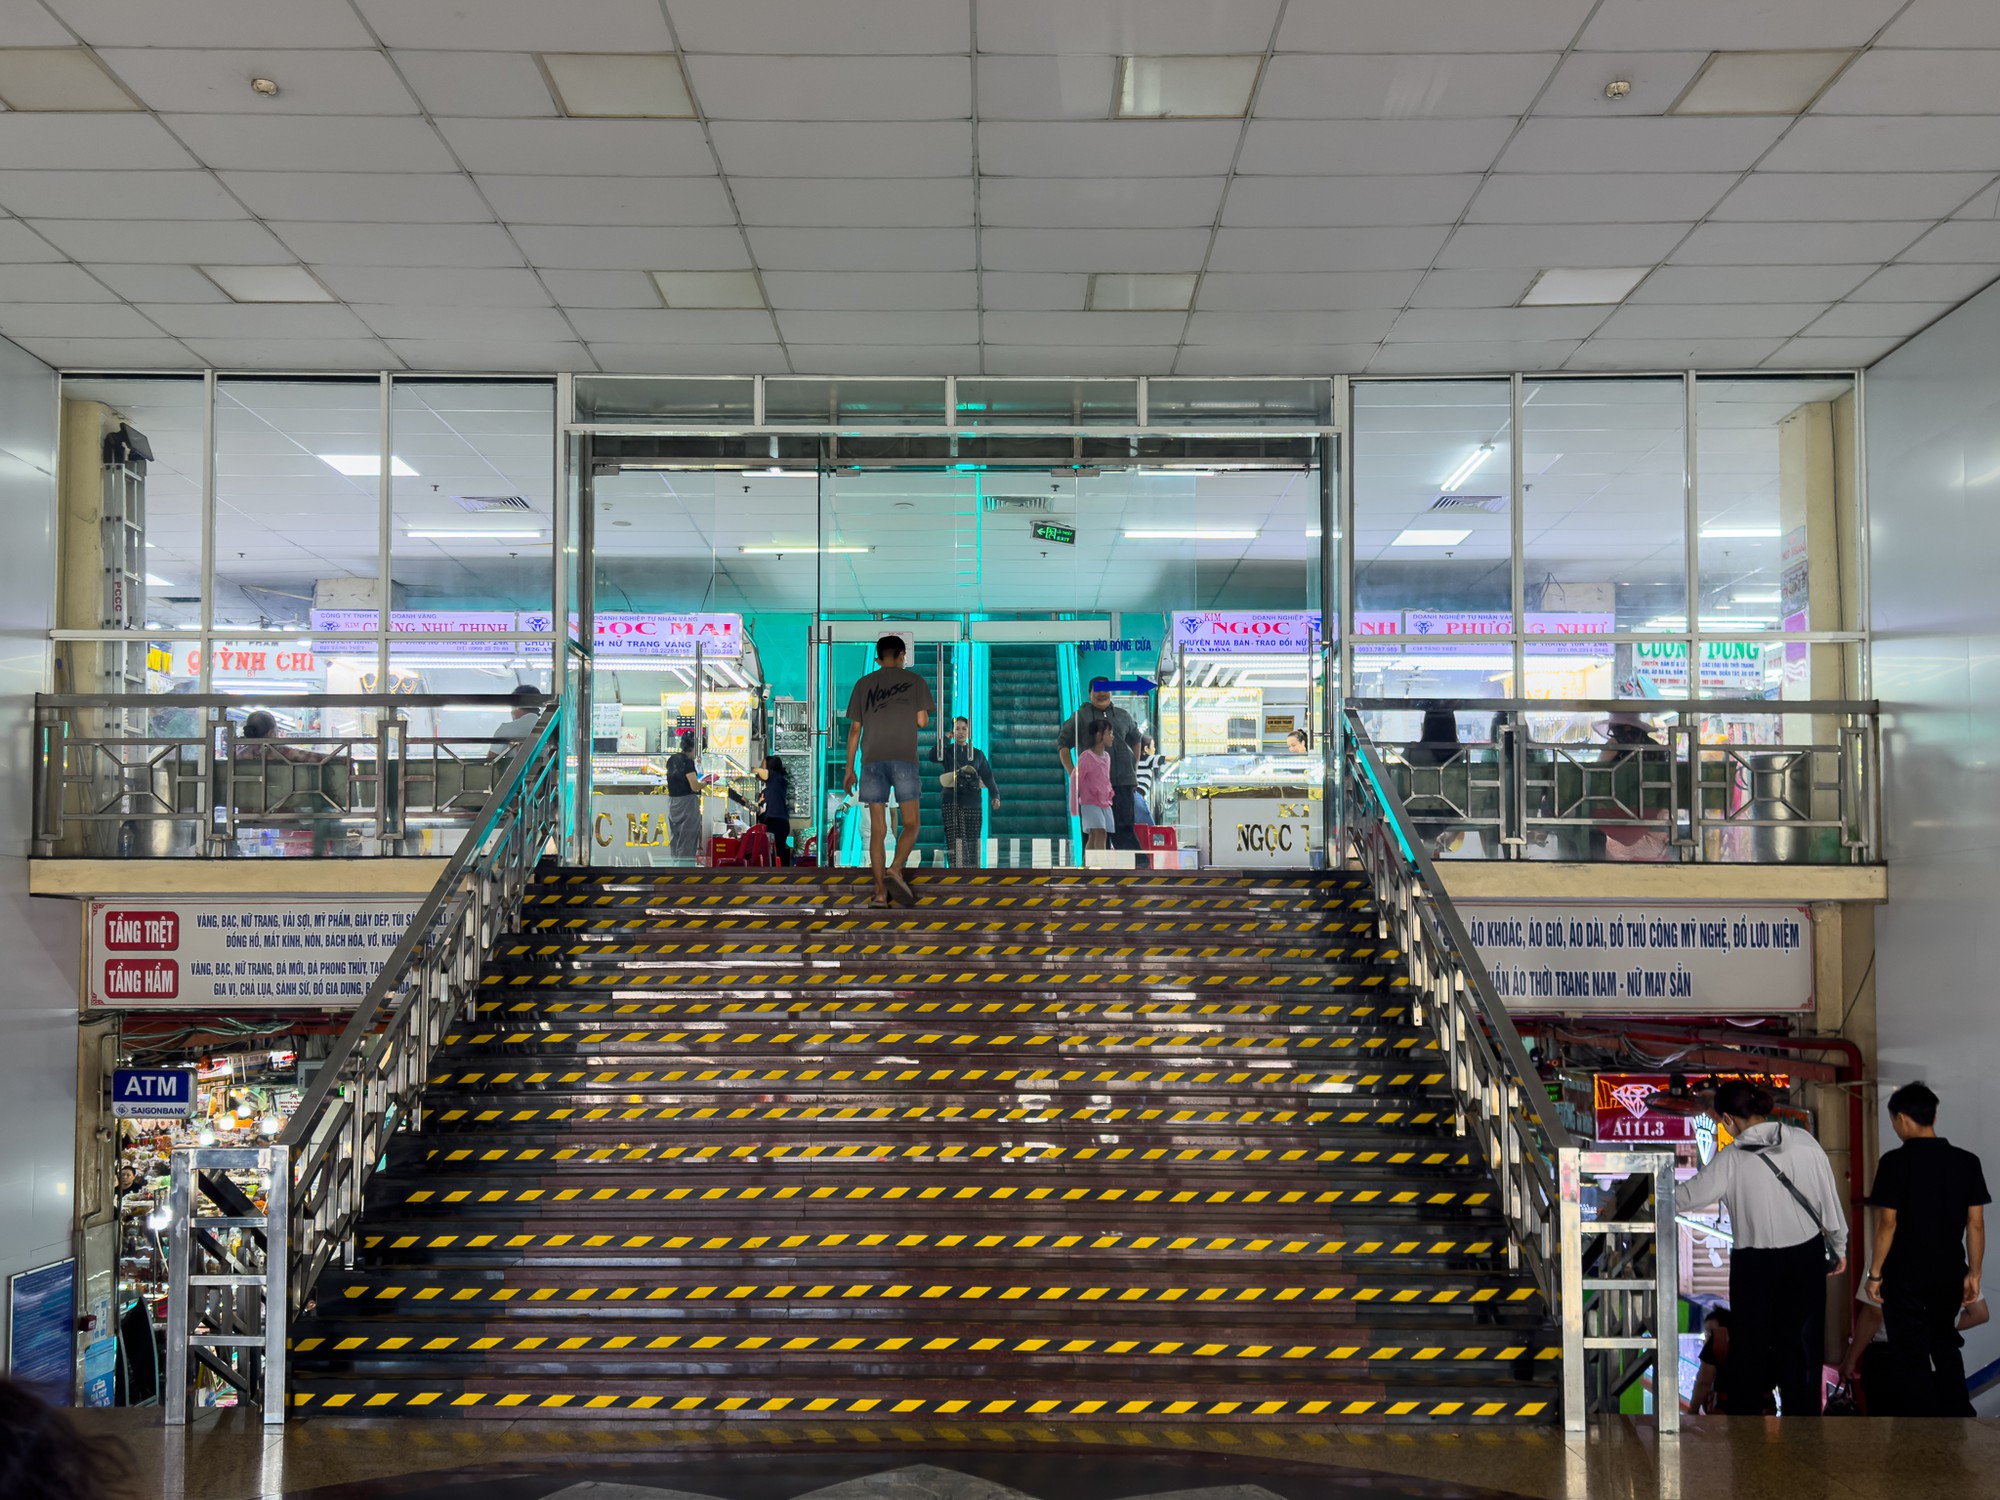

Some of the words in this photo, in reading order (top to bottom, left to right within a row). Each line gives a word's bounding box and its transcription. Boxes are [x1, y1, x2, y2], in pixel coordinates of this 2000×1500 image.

[1440, 613, 1466, 621] NGHIỆP
[1478, 613, 1498, 621] NHÂN
[1446, 620, 1546, 634] PHƯƠG
[670, 622, 731, 636] MAI
[1211, 621, 1292, 638] NGỌC
[608, 640, 623, 648] NỮ
[1080, 640, 1090, 651] RA
[1093, 638, 1107, 651] VÀO
[1109, 638, 1132, 651] ĐÓNG
[187, 647, 267, 675] QỲNH
[276, 651, 316, 671] CHI
[625, 812, 670, 847] MA
[1236, 823, 1293, 857] NGỌC
[197, 912, 219, 929] VÀNG,
[221, 914, 239, 930] BẠC,
[241, 912, 253, 928] NỮ
[254, 914, 281, 929] TRANG,
[314, 912, 326, 928] MỸ
[328, 909, 353, 928] PHẨM,
[355, 911, 372, 927] GIÀY
[374, 911, 390, 928] DÉP,
[392, 911, 403, 927] TÚI
[109, 912, 141, 943] TẦNG
[144, 916, 174, 948] TRỆT
[282, 932, 303, 948] KÍNH,
[304, 932, 323, 948] NÓN,
[325, 932, 346, 947] BÁCH
[348, 932, 365, 948] HÓA,
[1470, 916, 1484, 947] ÁO
[1487, 916, 1526, 949] KHOÁC,
[1528, 917, 1542, 947] ÁO
[1545, 917, 1567, 950] GIÓ,
[1569, 917, 1583, 947] ÁO
[1586, 917, 1607, 950] DÀI,
[1609, 914, 1624, 948] ĐỒ
[1626, 914, 1647, 948] THỦ
[1650, 917, 1678, 948] CÔNG
[1681, 918, 1697, 948] MỸ
[1700, 916, 1731, 953] NGHỆ,
[1733, 914, 1748, 948] ĐỒ
[1750, 920, 1769, 948] LƯU
[1772, 917, 1800, 953] NIỆM
[109, 962, 141, 993] TẦNG
[145, 962, 173, 993] HẦM
[191, 960, 213, 976] VÀNG,
[215, 962, 233, 978] BẠC,
[235, 961, 246, 976] NỮ
[248, 962, 274, 976] TRANG,
[276, 960, 286, 975] ĐÁ
[307, 960, 318, 975] ĐÁ
[320, 962, 346, 975] PHONG
[348, 957, 368, 976] THỦY,
[214, 983, 226, 995] GIA
[228, 983, 238, 998] VỊ,
[240, 978, 255, 995] CHẢ
[257, 983, 274, 998] LỤA,
[276, 980, 296, 995] SÀNH
[299, 980, 311, 996] SỨ,
[325, 983, 338, 995] GIA
[340, 982, 363, 997] DỤNG,
[1488, 962, 1509, 996] UẦN
[1512, 965, 1526, 996] ÁO
[1529, 965, 1553, 996] THỜI
[1555, 971, 1590, 997] TRANG
[1592, 971, 1617, 997] NAM
[1627, 967, 1643, 997] NỮ
[1644, 972, 1667, 997] MAY
[1669, 962, 1691, 997] SẴN
[124, 1075, 177, 1097] ATM
[131, 1106, 186, 1115] SAIGONBANK
[1613, 1120, 1665, 1137] A111.3
